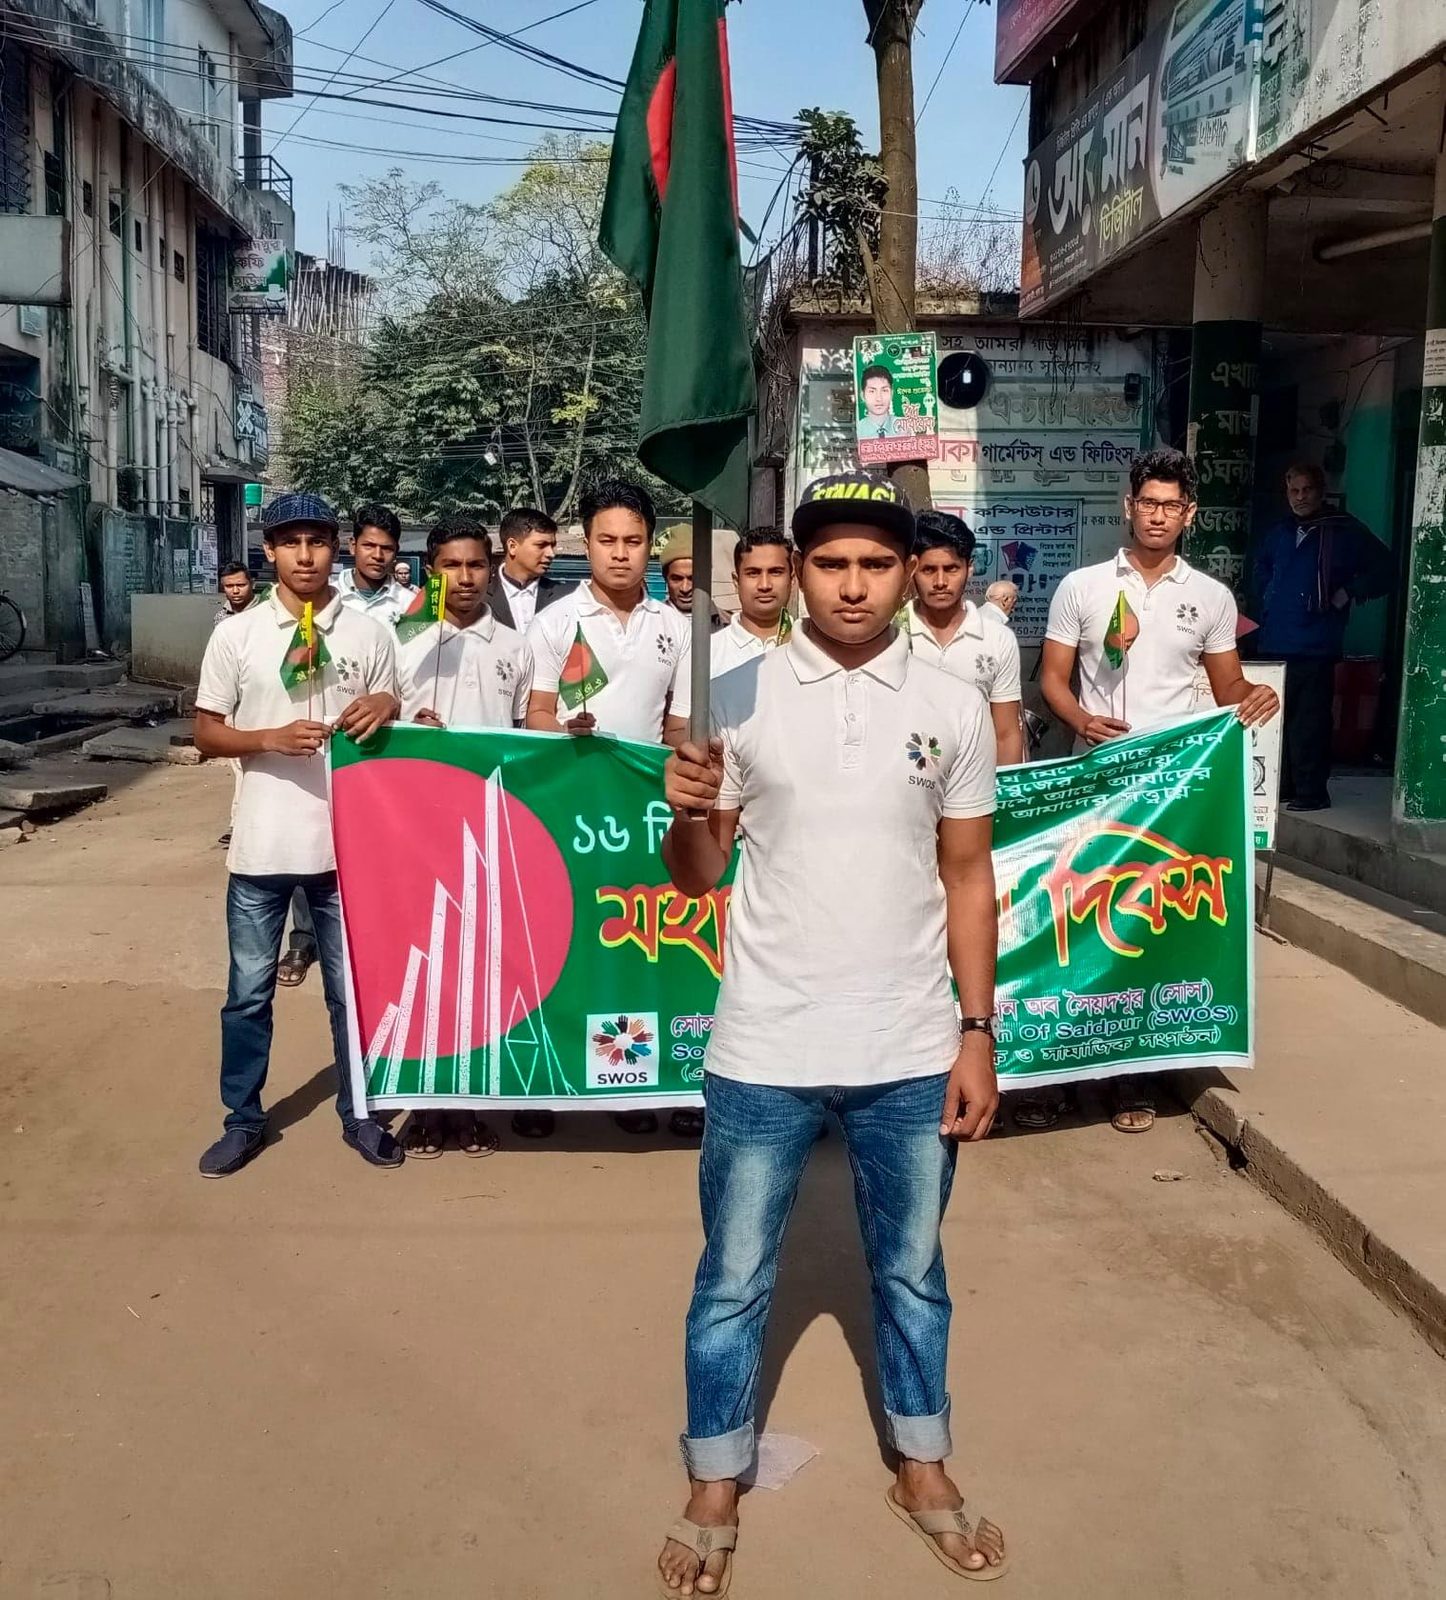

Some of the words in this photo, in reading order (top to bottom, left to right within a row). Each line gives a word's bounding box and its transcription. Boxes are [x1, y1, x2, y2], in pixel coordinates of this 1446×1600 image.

[939, 439, 980, 463] াকা
[908, 775, 936, 790] SWOS
[573, 814, 630, 855] ১৬
[595, 884, 731, 981] মহা
[1022, 996, 1061, 1020] অব
[1019, 1023, 1050, 1042] Of
[1054, 1015, 1144, 1040] Saidpur
[1146, 1005, 1239, 1030] (SWOS)
[1013, 1048, 1035, 1064] ও
[597, 1070, 648, 1086] SWOS
